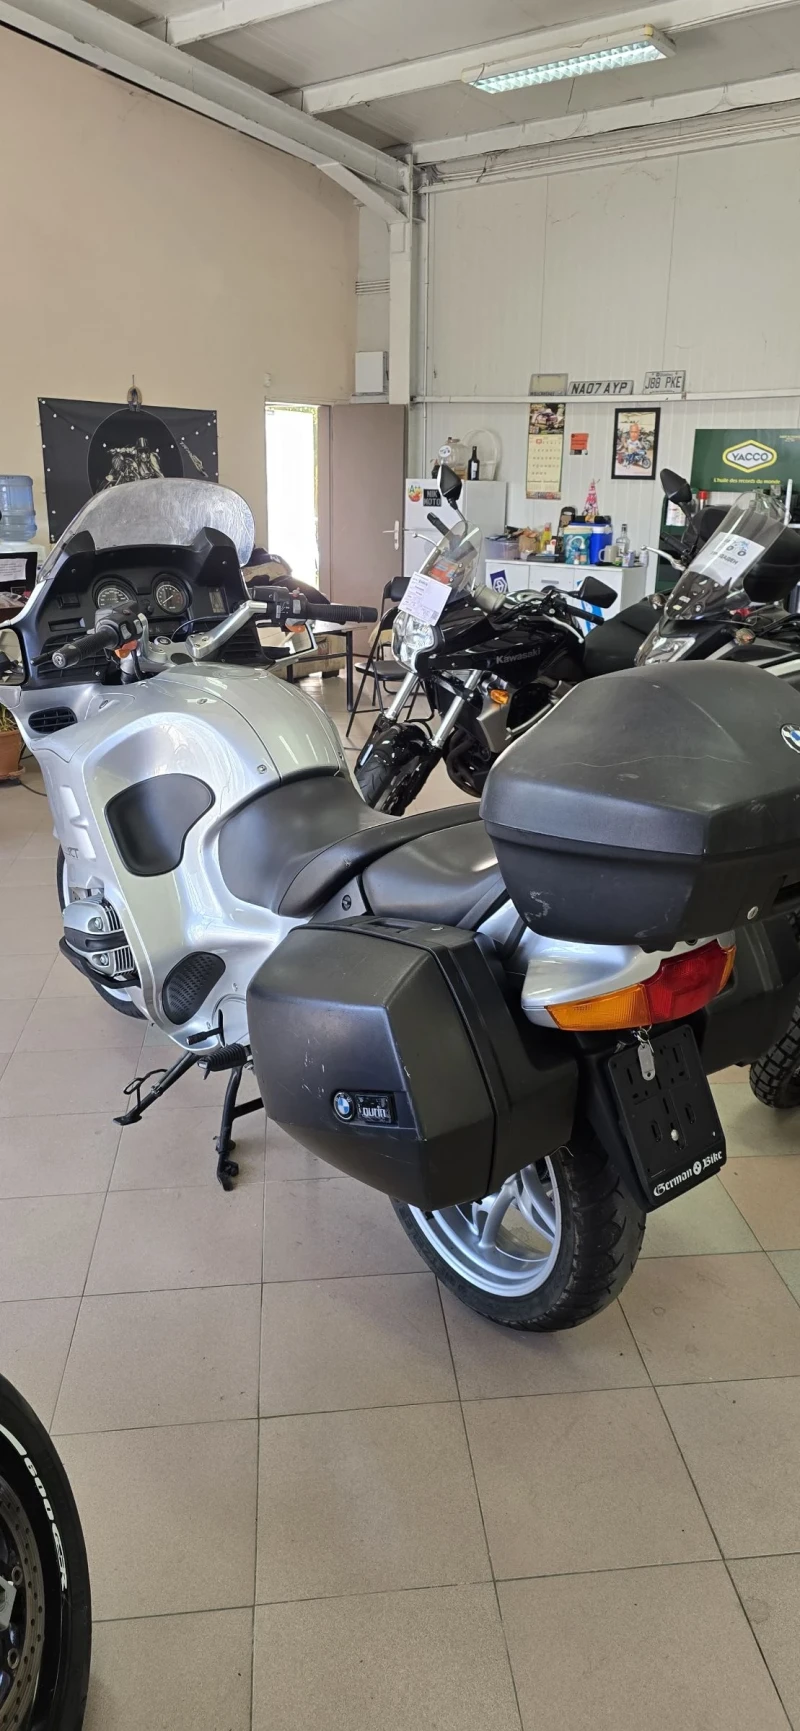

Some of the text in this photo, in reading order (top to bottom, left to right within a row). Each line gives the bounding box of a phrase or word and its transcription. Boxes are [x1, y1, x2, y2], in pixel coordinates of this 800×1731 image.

[571, 381, 628, 395] NA07 AYP
[665, 375, 682, 388] PKE
[732, 452, 769, 461] YACCO
[424, 498, 441, 506] MOTO
[496, 647, 541, 664] Kawasaki
[653, 1150, 723, 1196] German Bike
[24, 1457, 54, 1521] 600
